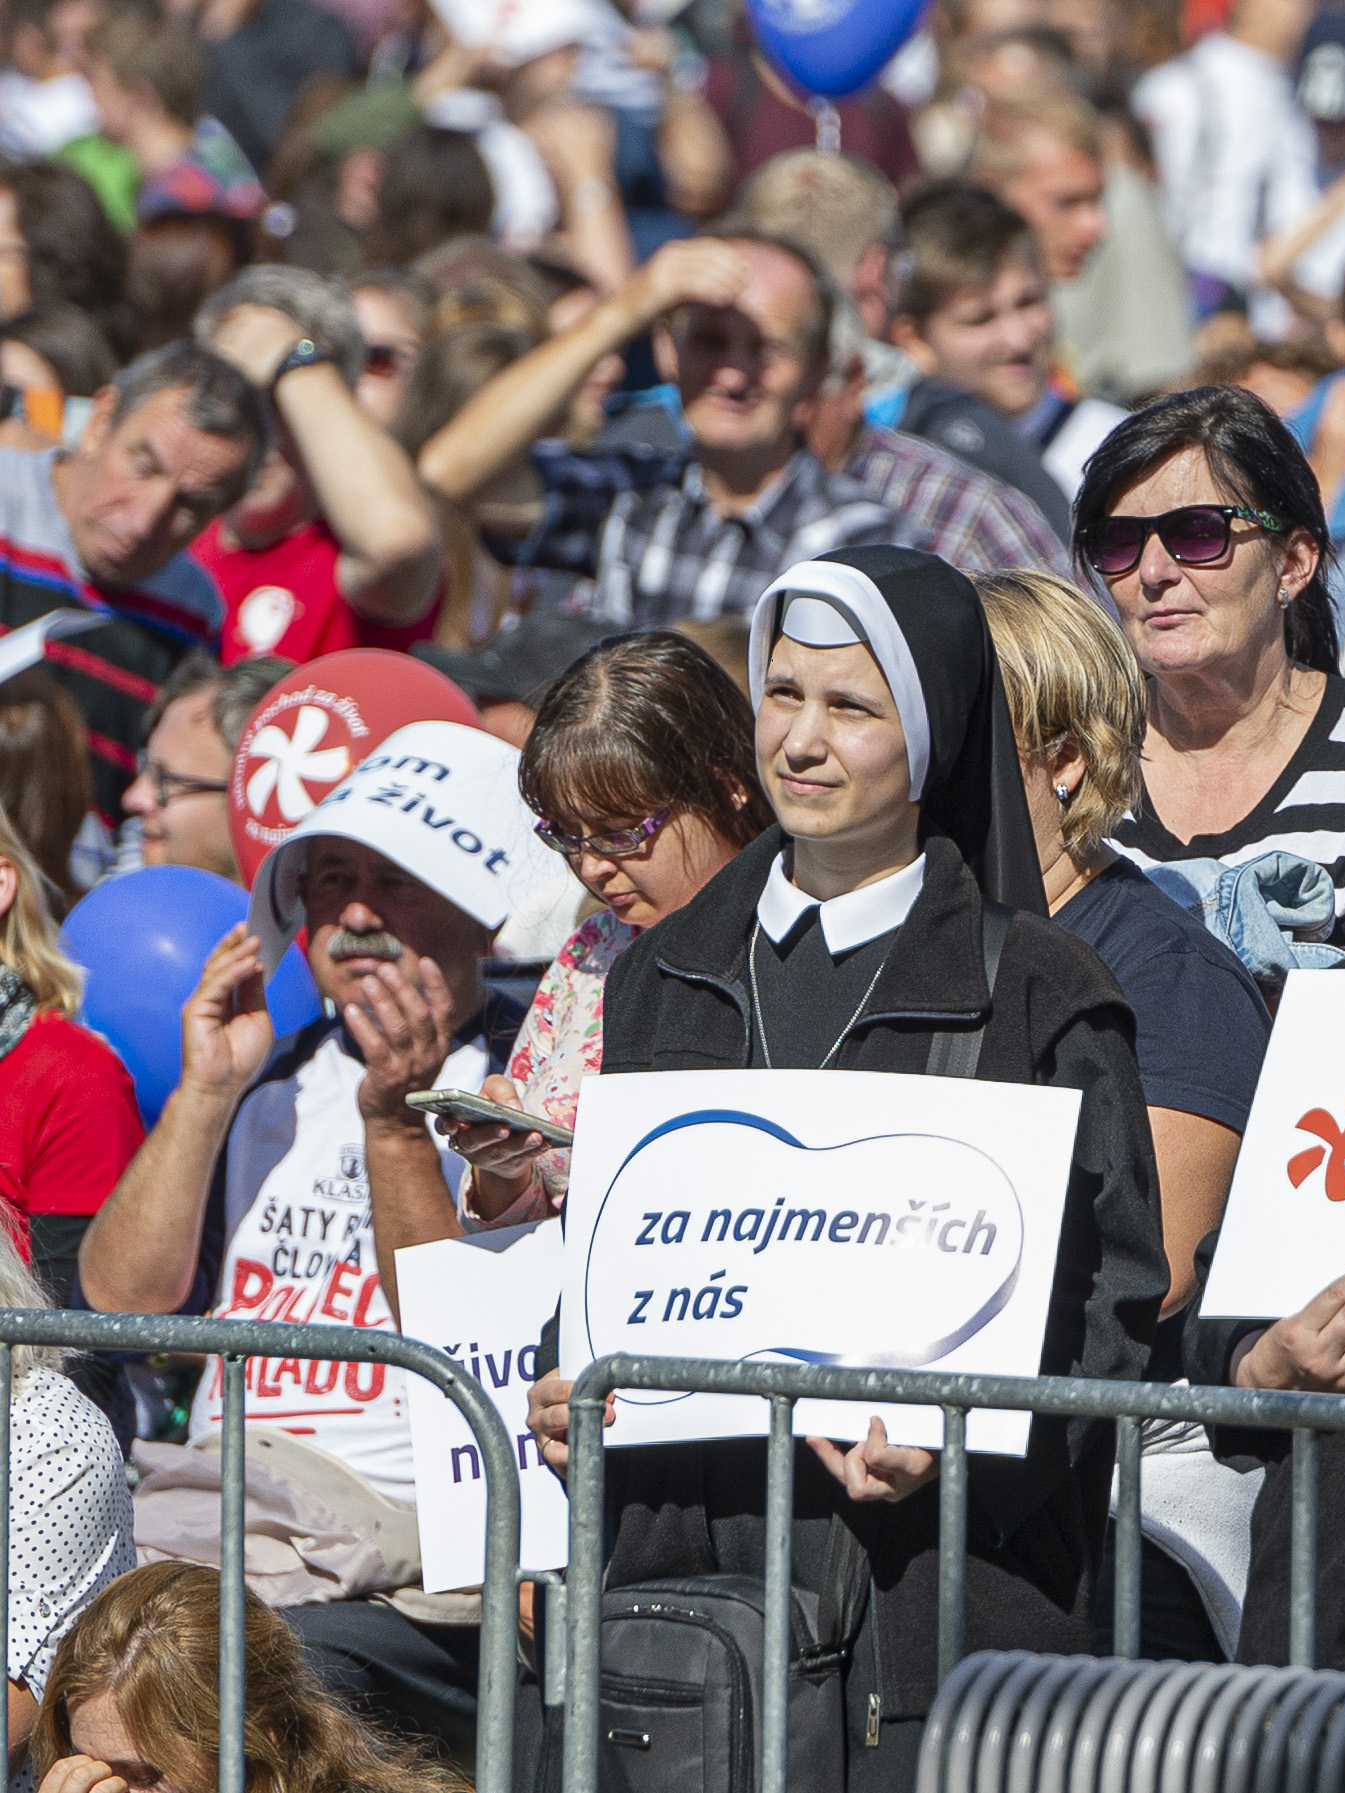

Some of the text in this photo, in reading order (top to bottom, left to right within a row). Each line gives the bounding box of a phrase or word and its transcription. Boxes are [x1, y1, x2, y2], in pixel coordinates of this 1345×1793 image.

[356, 754, 452, 783] om
[366, 782, 510, 876] život
[260, 1196, 337, 1241] ŠATY
[634, 1196, 998, 1256] za najmenších
[627, 1268, 749, 1325] z nás
